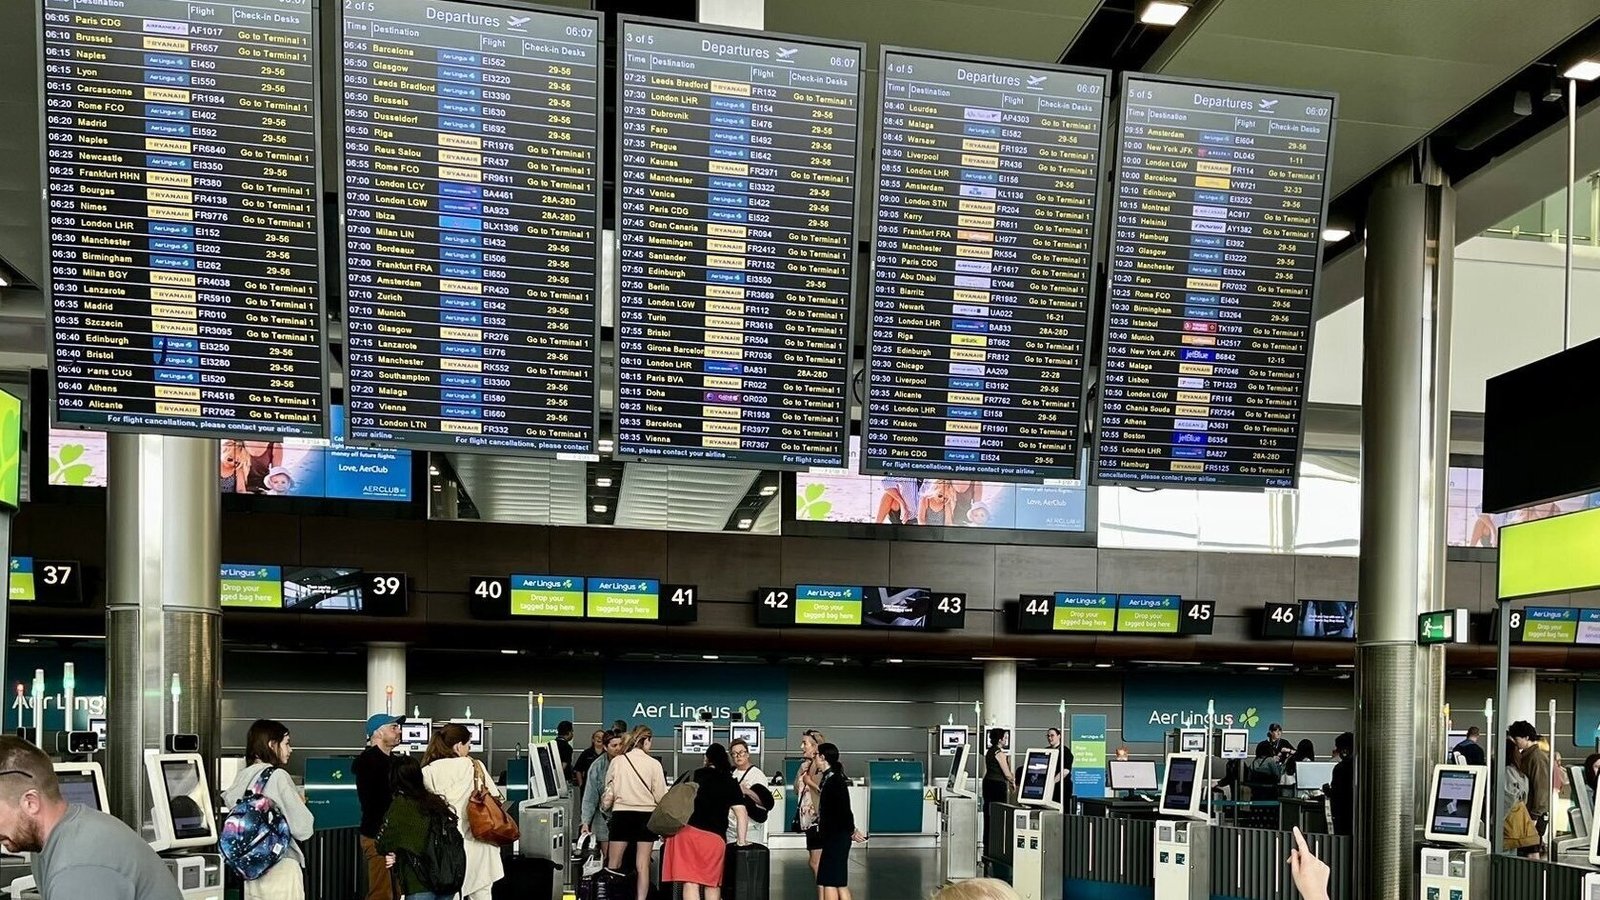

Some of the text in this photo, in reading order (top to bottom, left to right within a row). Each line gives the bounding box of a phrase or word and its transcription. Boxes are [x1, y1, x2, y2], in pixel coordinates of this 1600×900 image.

[191, 7, 215, 16] Flight
[353, 2, 362, 11] of
[235, 10, 300, 24] Check-in Desks
[426, 8, 500, 27] Departures
[566, 26, 592, 38] 06:07
[627, 34, 653, 44] 3 of 5
[702, 40, 769, 59] Departures
[344, 42, 367, 51] 06:45
[373, 44, 413, 56] Barcelona
[549, 66, 571, 75] 29-56
[831, 57, 855, 68] 06:07
[896, 65, 905, 73] of
[957, 69, 1020, 86] Departures
[47, 82, 225, 104] 06:15 Carcassonne FR1984
[1077, 84, 1100, 94] 06:07
[1130, 90, 1135, 98] 5
[1137, 91, 1145, 99] of
[1194, 94, 1253, 110] Departures
[1306, 107, 1328, 116] 06:07
[345, 109, 368, 118] 06:50
[374, 112, 418, 123] Dusseldorf
[548, 131, 571, 140] 29-56
[624, 106, 646, 115] 07:35
[651, 109, 689, 120] Dubrovnik
[812, 126, 832, 135] 29-56
[883, 134, 902, 142] 08:45
[908, 136, 935, 145] Warsaw
[49, 149, 73, 159] 06:25
[79, 151, 123, 163] Newcastle
[263, 168, 287, 177] 29-56
[1119, 201, 1137, 209] 10:15
[1142, 204, 1170, 212] Montreal
[51, 234, 76, 243] 06:30
[81, 236, 130, 246] Manchester
[266, 250, 290, 259] 29-56
[622, 265, 643, 273] 07:50
[648, 267, 685, 278] Edinburgh
[1110, 332, 1127, 340] 10:40
[1131, 334, 1154, 342] Munich
[351, 369, 373, 379] 07:20
[379, 371, 430, 382] Southampton
[546, 383, 568, 391] 29-56
[871, 375, 891, 383] 09:30
[896, 377, 926, 386] Liverpool
[621, 388, 641, 396] 08:15
[108, 415, 121, 423] For
[123, 415, 143, 425] flight
[201, 420, 225, 429] please
[228, 422, 254, 431] contact
[278, 425, 300, 433] airline
[339, 464, 358, 472] Love,
[44, 566, 72, 584] 37
[229, 569, 255, 578] Lingus
[223, 584, 241, 592] Drop
[373, 577, 400, 594] 39
[475, 581, 502, 598] 40
[537, 580, 561, 589] Lingus
[613, 583, 636, 591] Lingus
[239, 594, 253, 602] bag
[531, 595, 546, 603] Drop
[671, 589, 692, 605] 41
[820, 590, 841, 598] Lingus
[607, 597, 623, 605] Drop
[764, 592, 788, 608] 42
[938, 597, 960, 613] 43
[1077, 597, 1096, 605] Lingus
[520, 603, 541, 611] tagged
[543, 603, 558, 611] bag
[597, 605, 617, 613] tagged
[814, 604, 828, 612] Drop
[1026, 600, 1049, 615] 44
[1188, 605, 1210, 620] 45
[804, 611, 825, 619] tagged
[1271, 607, 1293, 623] 46
[1510, 613, 1520, 628] 8
[632, 703, 666, 717] Aer
[1149, 711, 1178, 724] Aer
